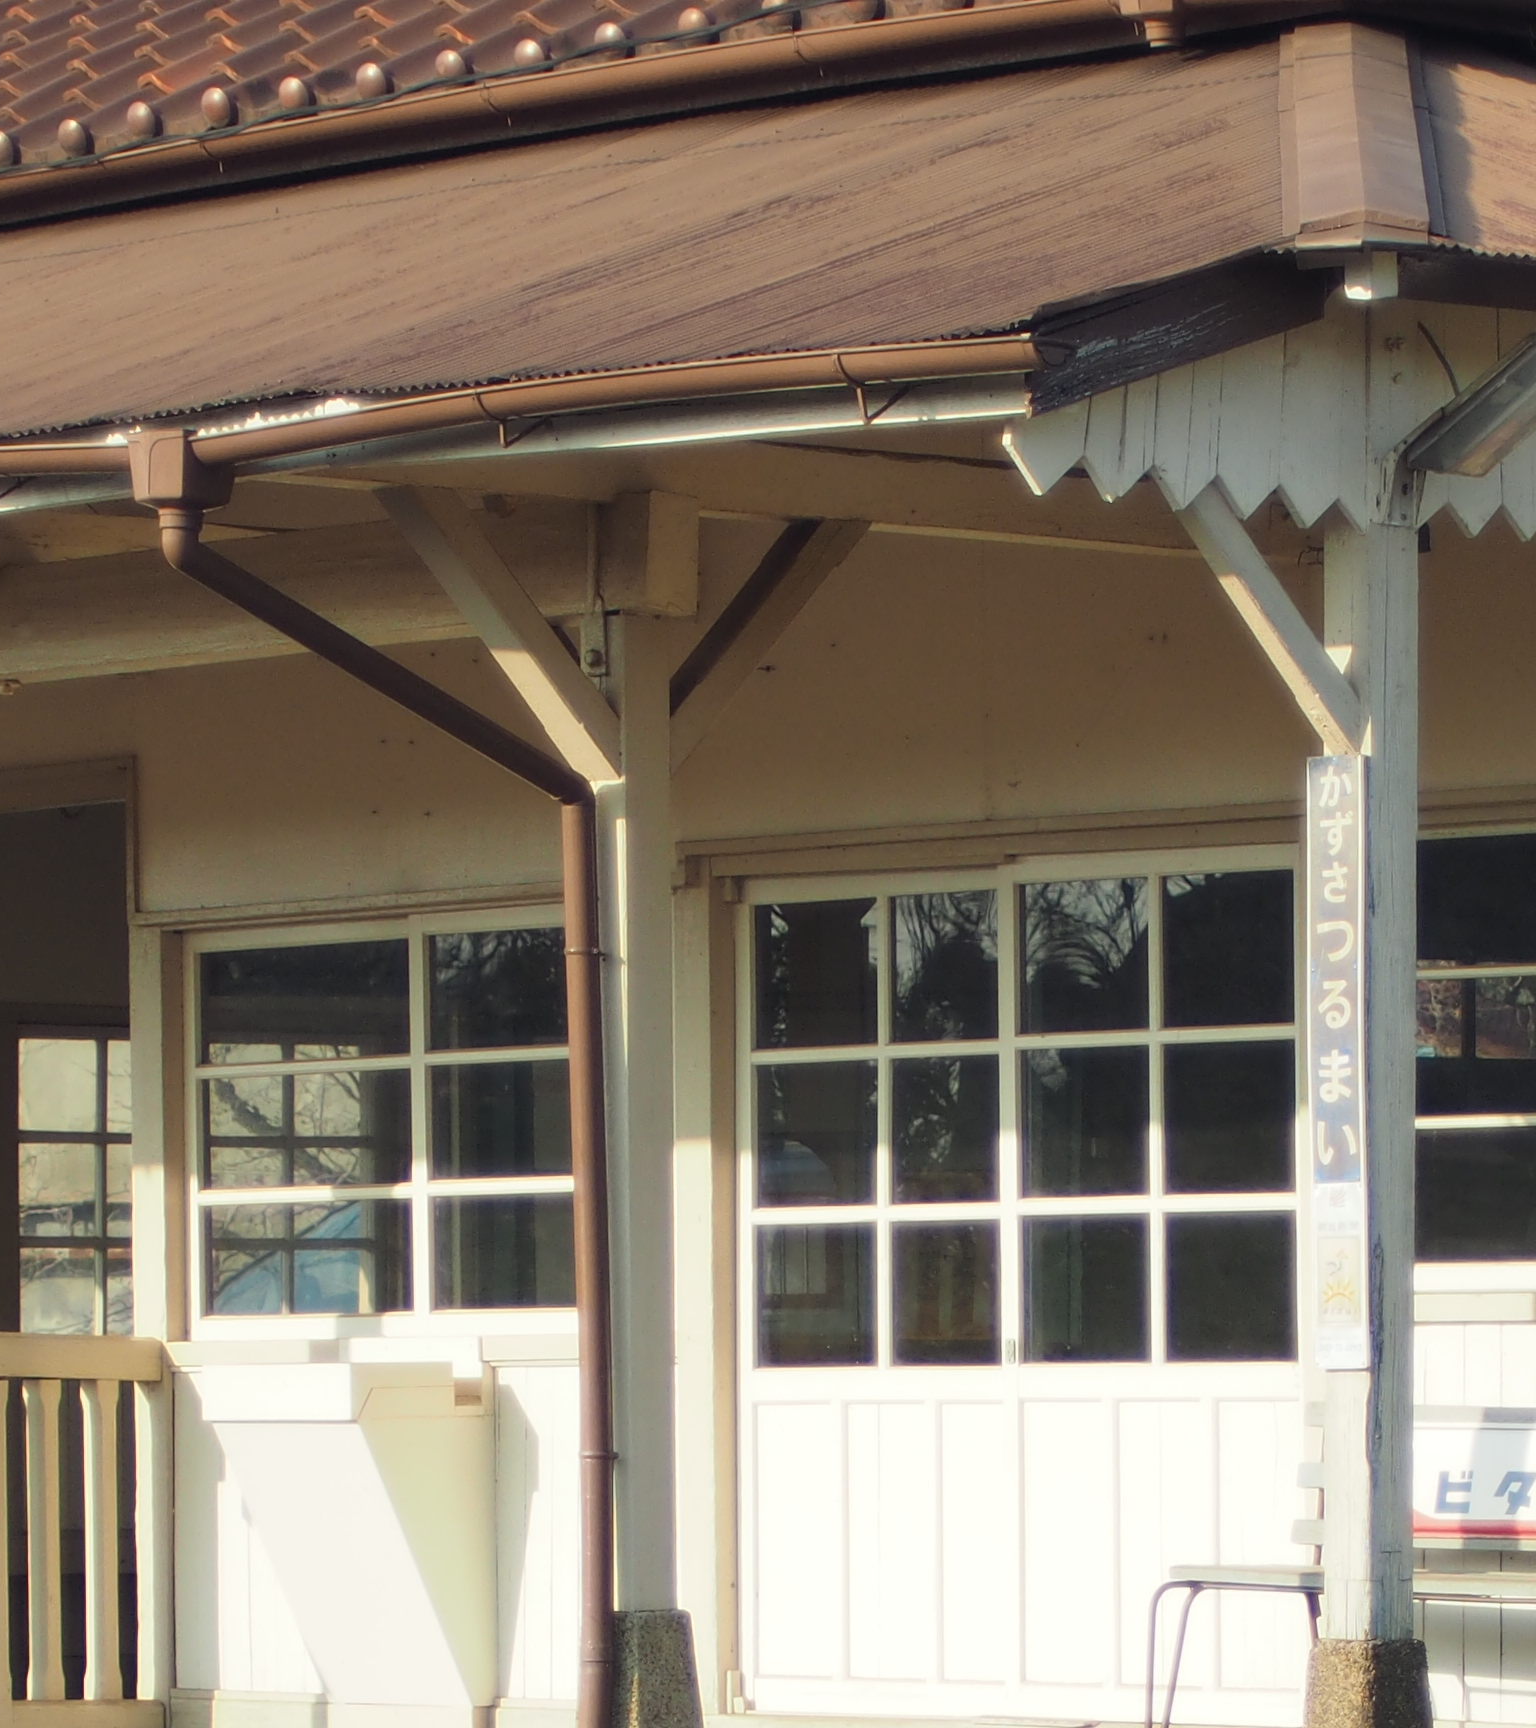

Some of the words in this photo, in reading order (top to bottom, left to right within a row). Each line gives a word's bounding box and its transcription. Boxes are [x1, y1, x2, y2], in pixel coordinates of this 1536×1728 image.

[1317, 765, 1357, 1166] かずさつるまい
